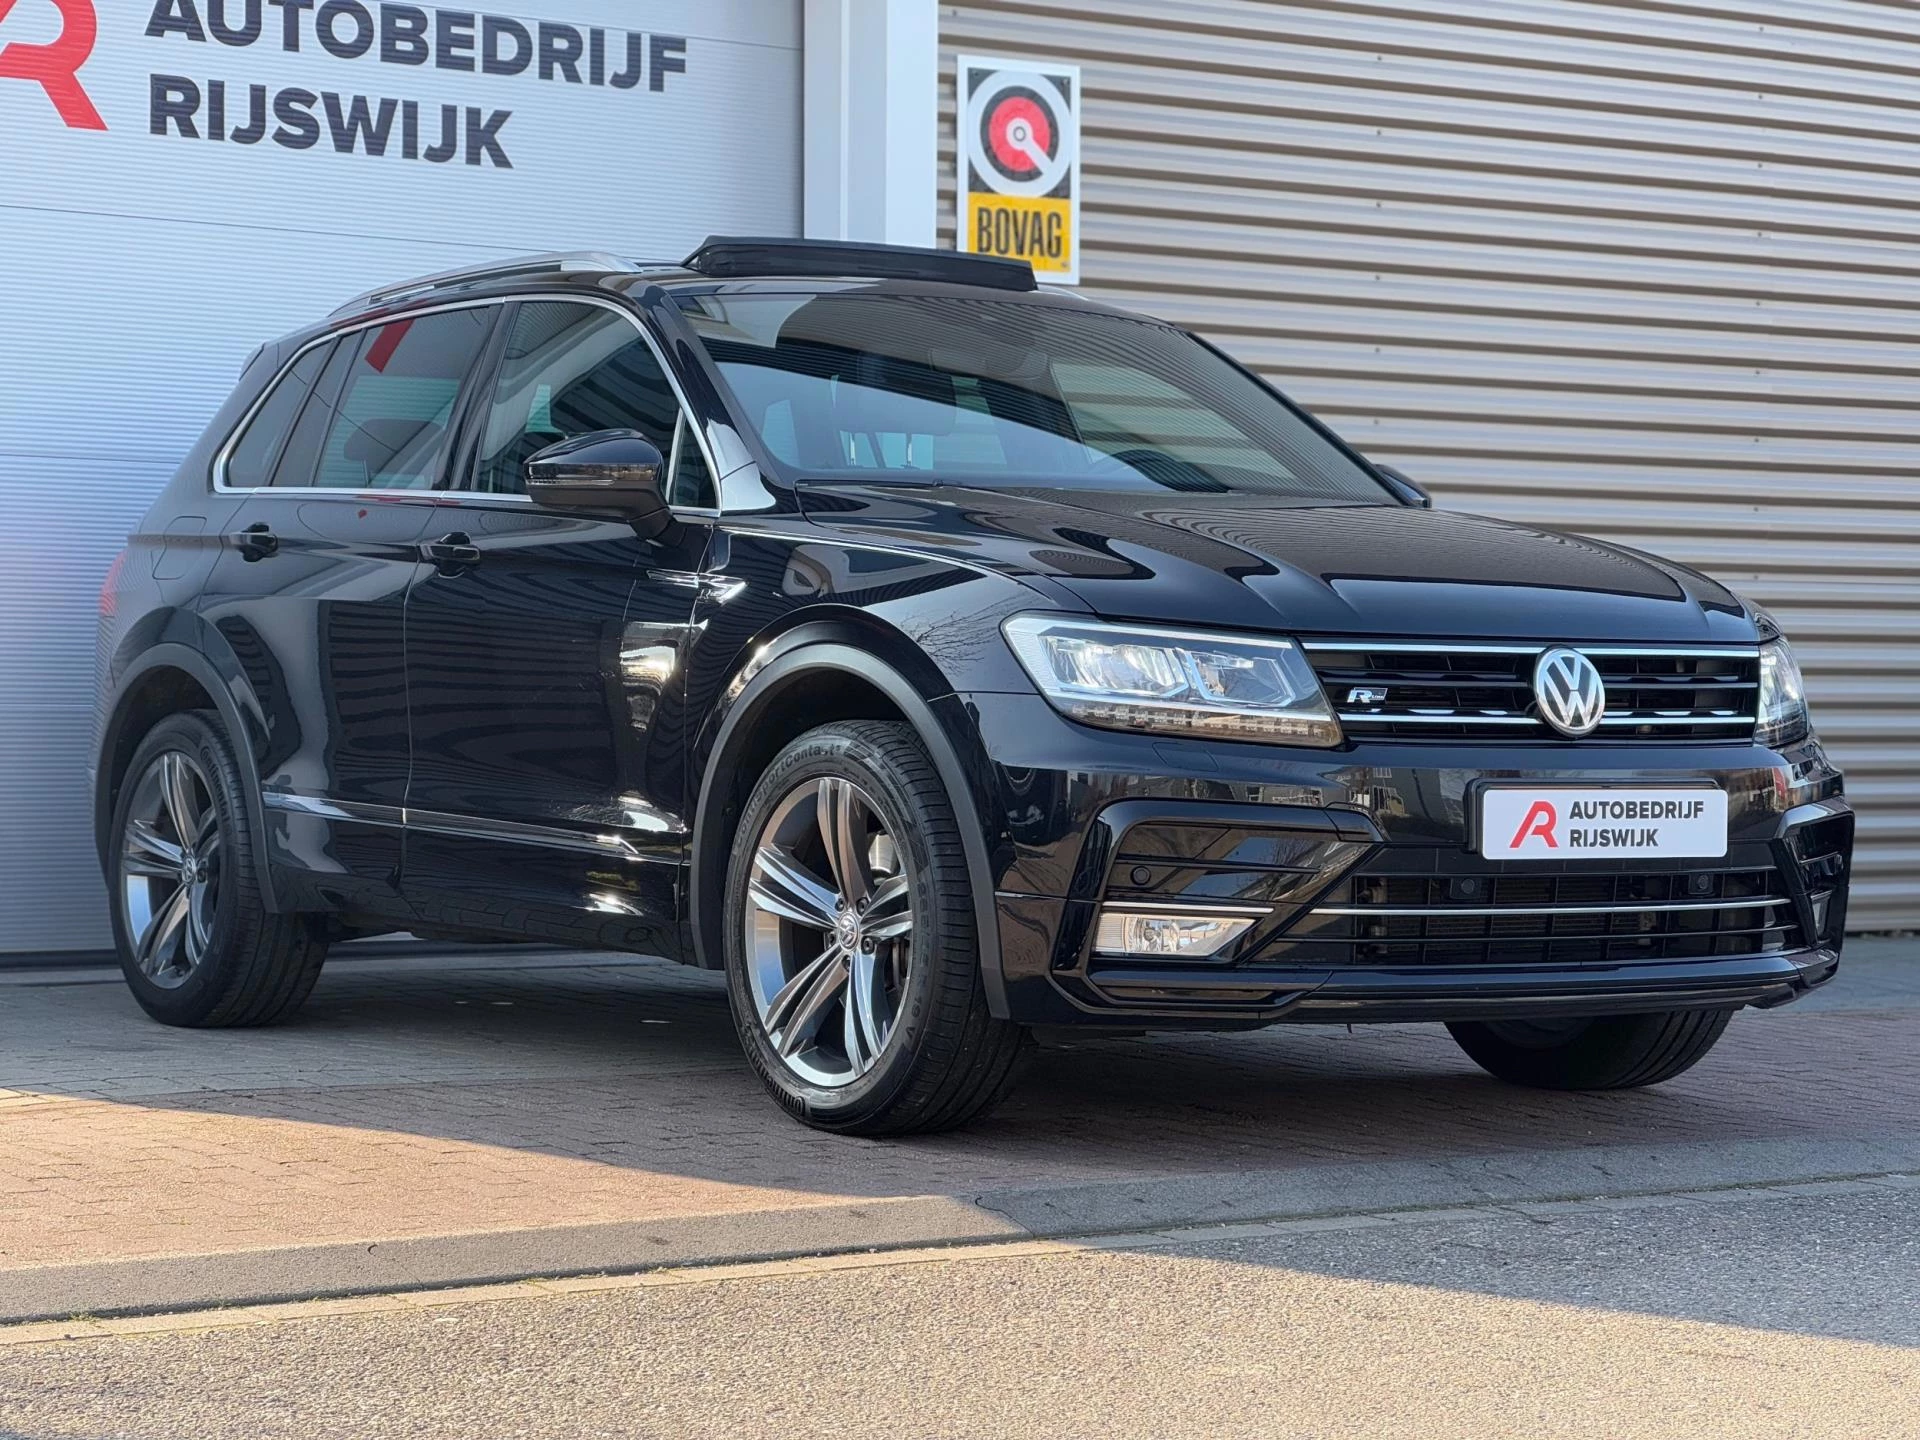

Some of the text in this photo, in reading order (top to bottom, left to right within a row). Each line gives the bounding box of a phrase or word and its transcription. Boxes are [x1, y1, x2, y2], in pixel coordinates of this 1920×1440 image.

[145, 0, 688, 93] AUTOBEDRIJF
[149, 73, 515, 169] RIJSWIJK
[977, 207, 1062, 258] BOVAG
[1569, 801, 1704, 819] AUTOBEDRIJF
[1569, 828, 1659, 848] RIJSWIJK
